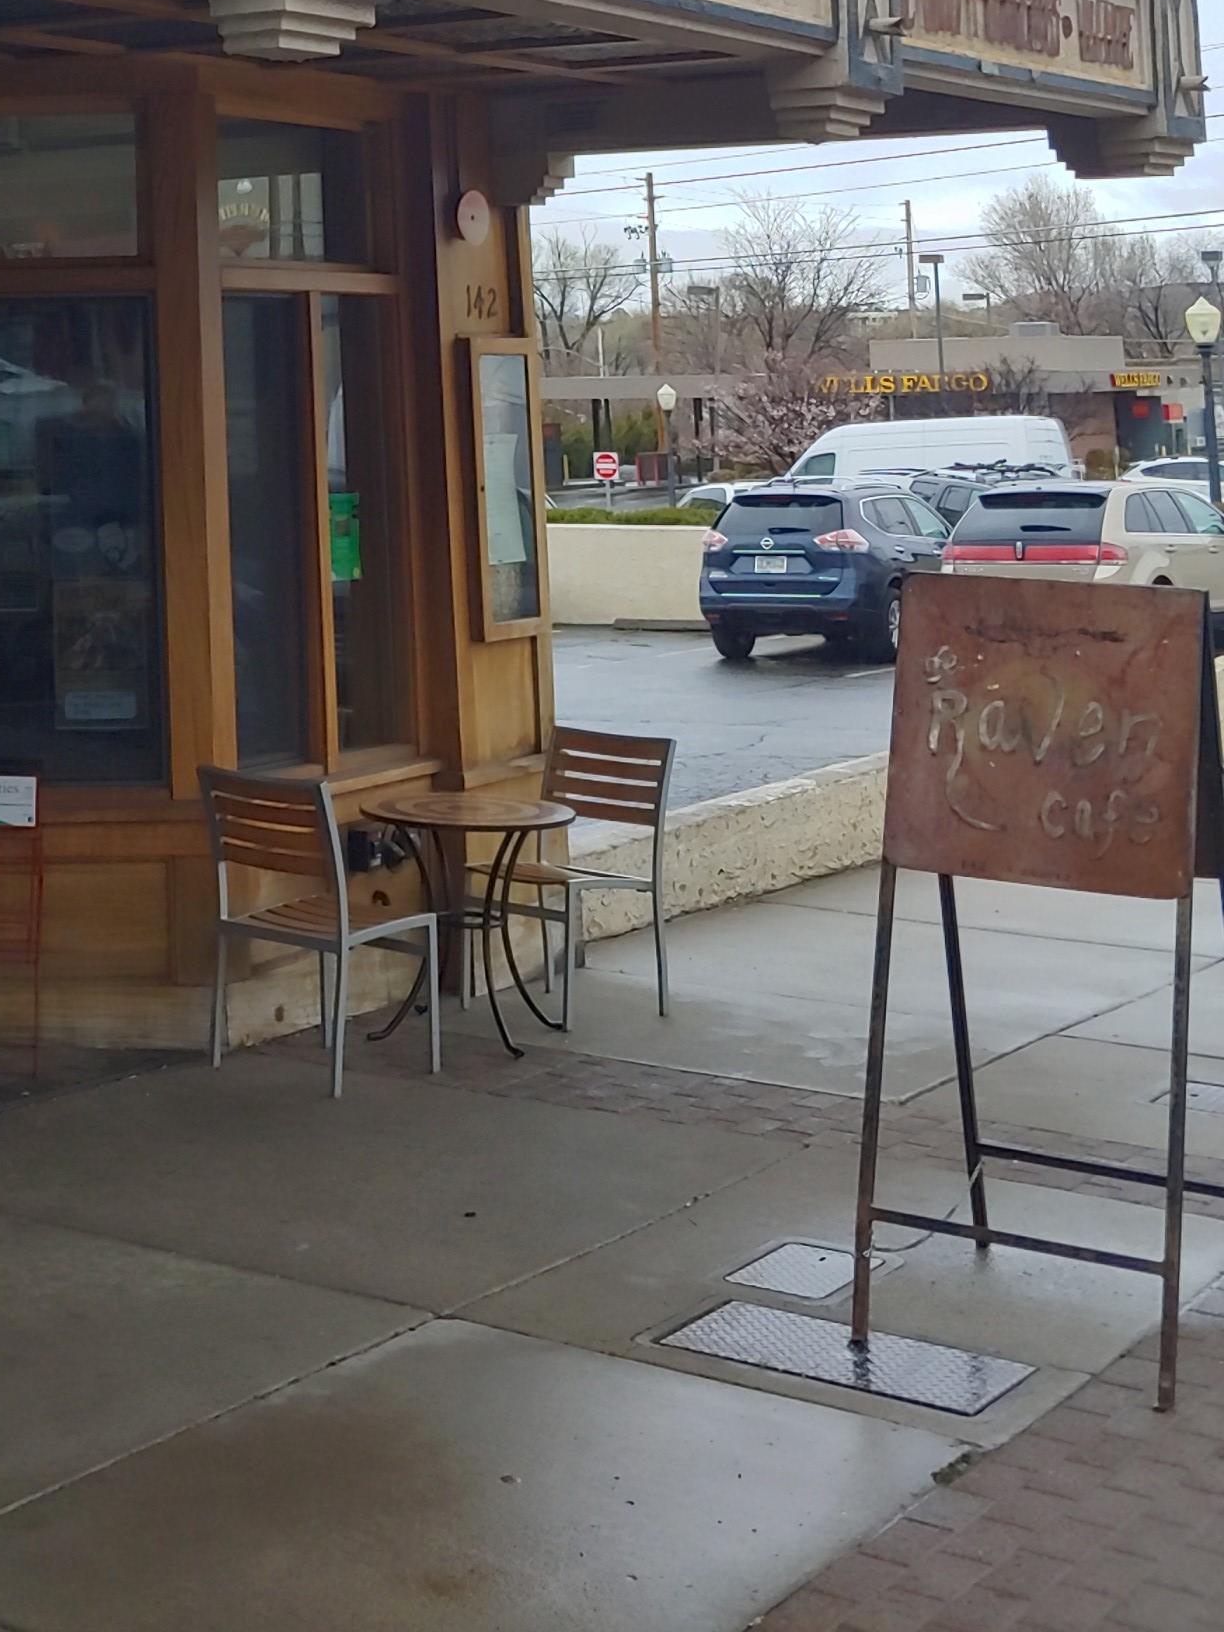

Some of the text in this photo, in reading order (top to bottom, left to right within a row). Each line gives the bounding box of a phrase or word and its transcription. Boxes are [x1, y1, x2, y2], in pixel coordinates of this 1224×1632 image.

[464, 283, 498, 320] 142
[818, 372, 990, 395] WLLS FARGO
[1113, 372, 1161, 388] WELLS FARGO
